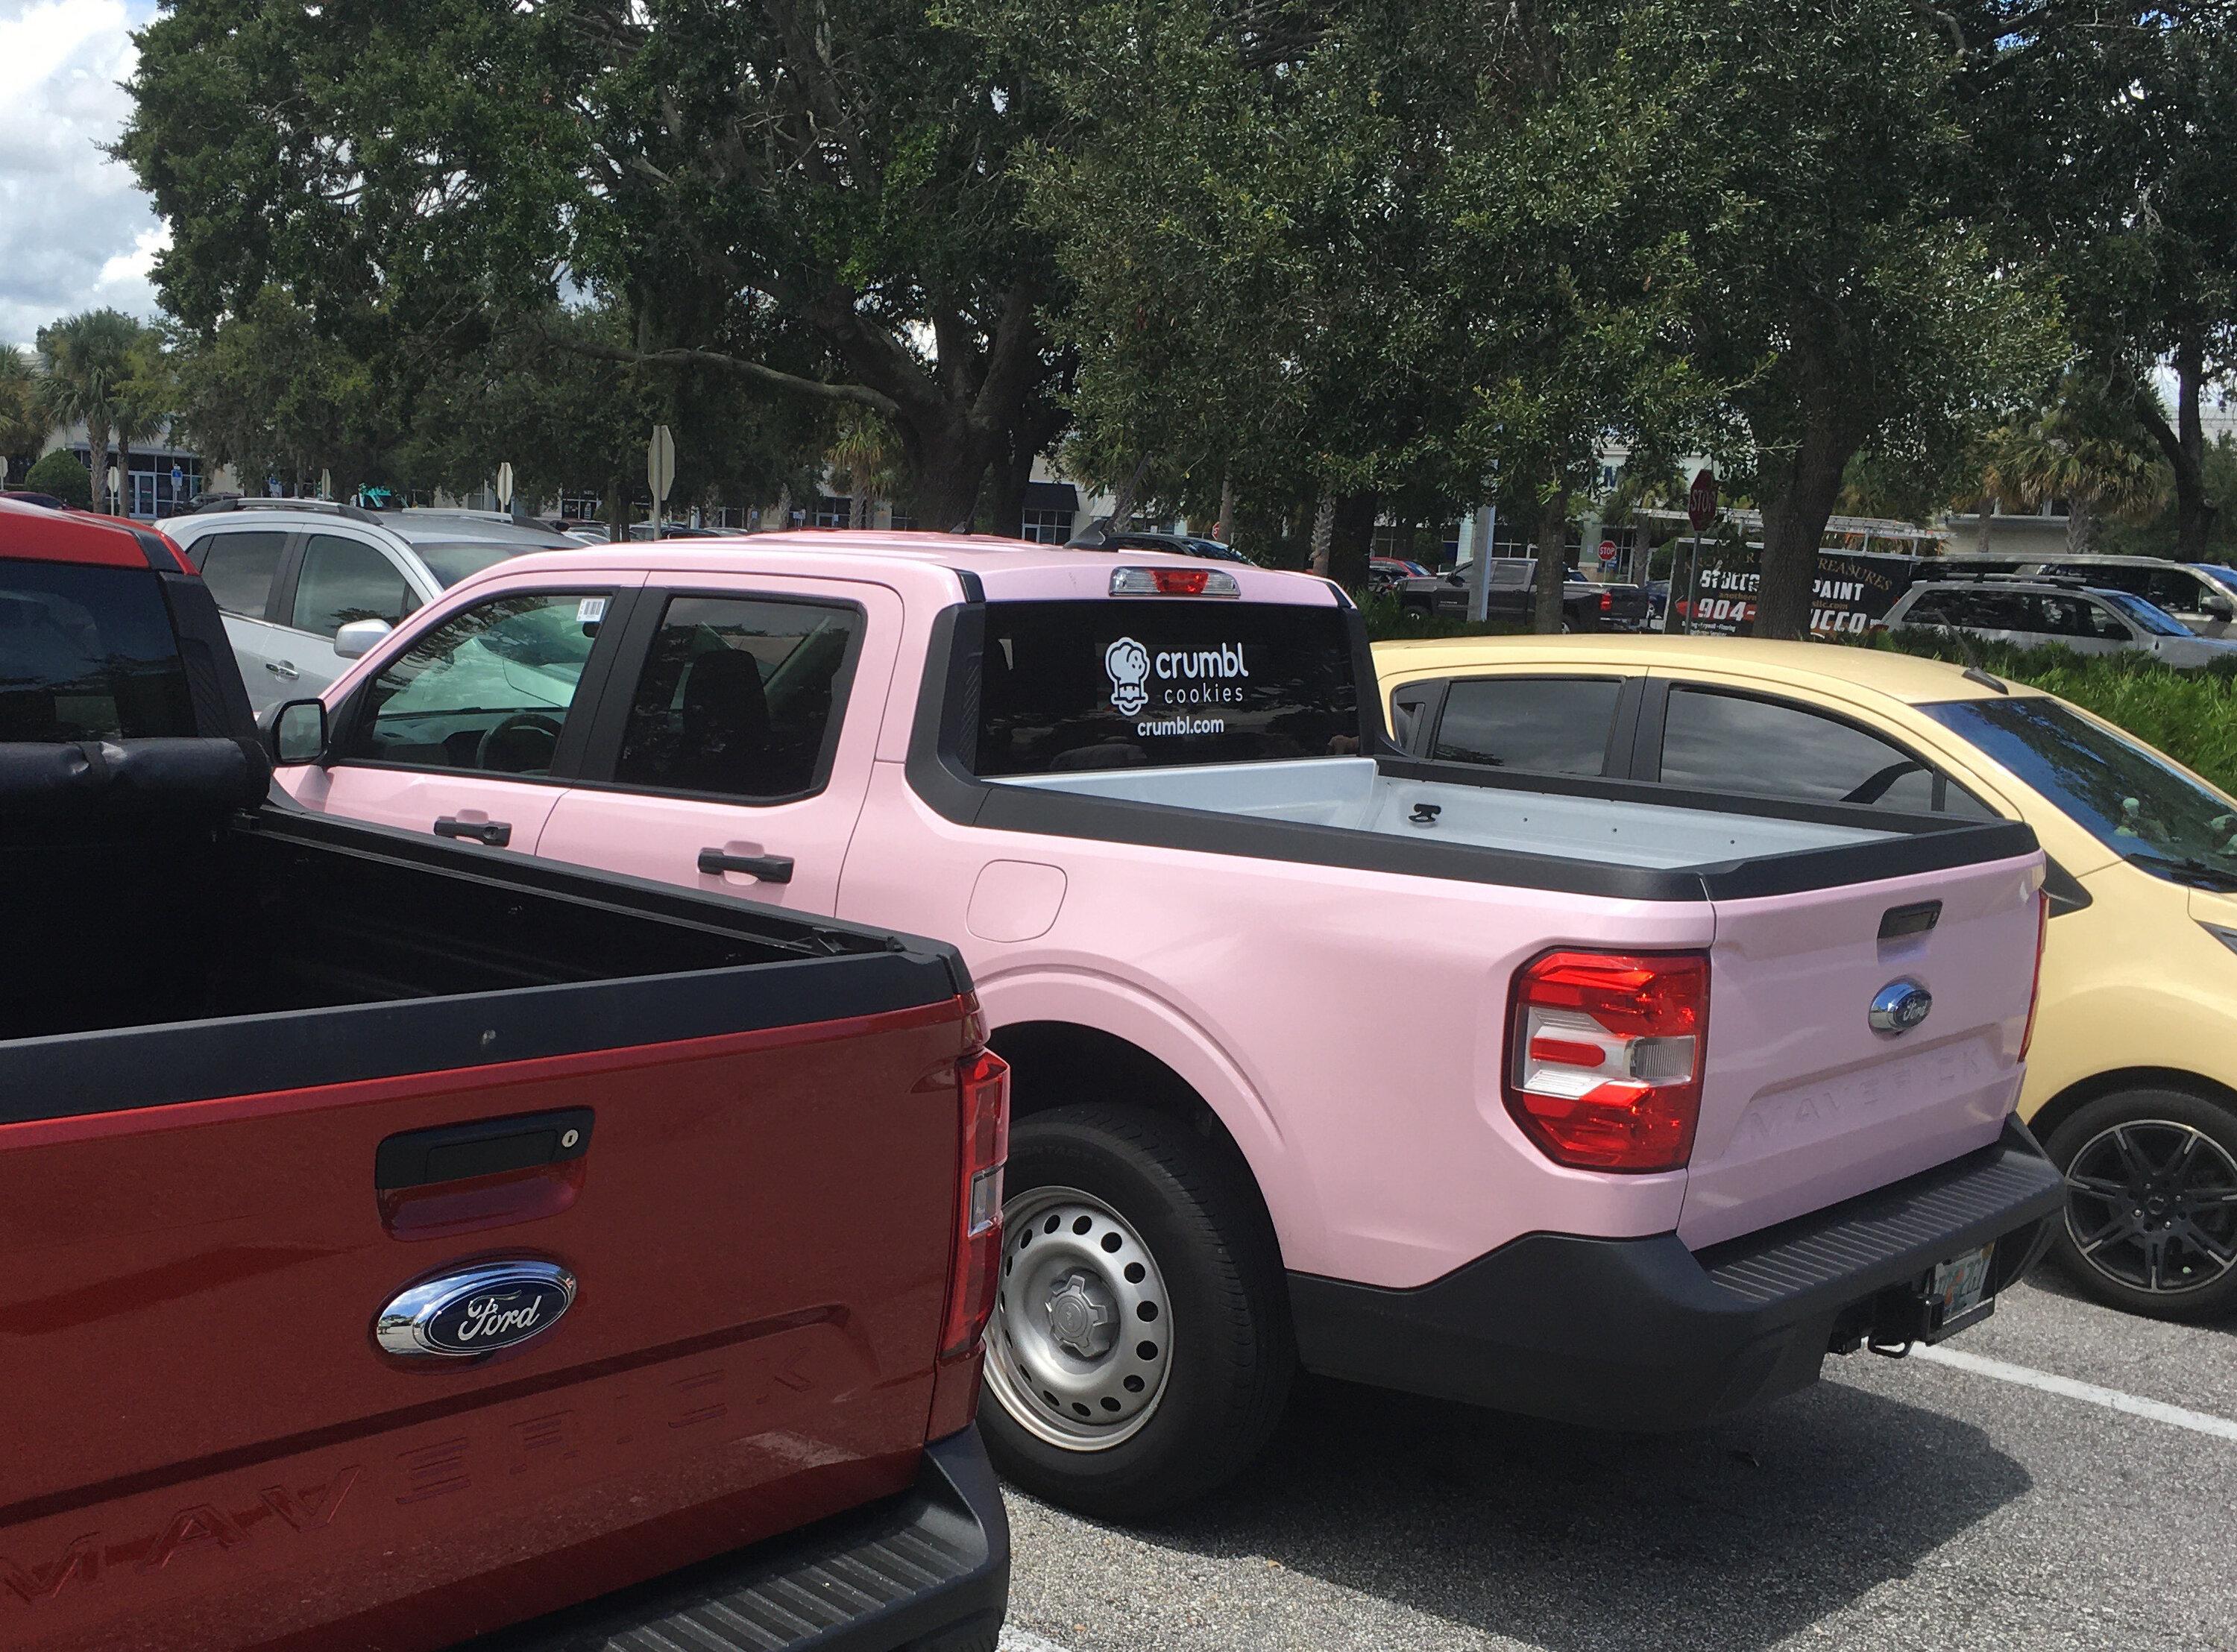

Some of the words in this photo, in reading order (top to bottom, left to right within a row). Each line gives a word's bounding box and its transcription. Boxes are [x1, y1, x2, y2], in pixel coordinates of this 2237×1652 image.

[1599, 546, 1614, 555] STOP
[1817, 558, 1893, 591] REASURES
[1156, 642, 1249, 679] crumbl
[1165, 683, 1243, 704] cookies
[1137, 716, 1224, 737] crumbl.com
[1903, 997, 1928, 1021] Ford
[458, 1290, 543, 1340] Ford
[0, 1346, 814, 1603] MAVERICK
